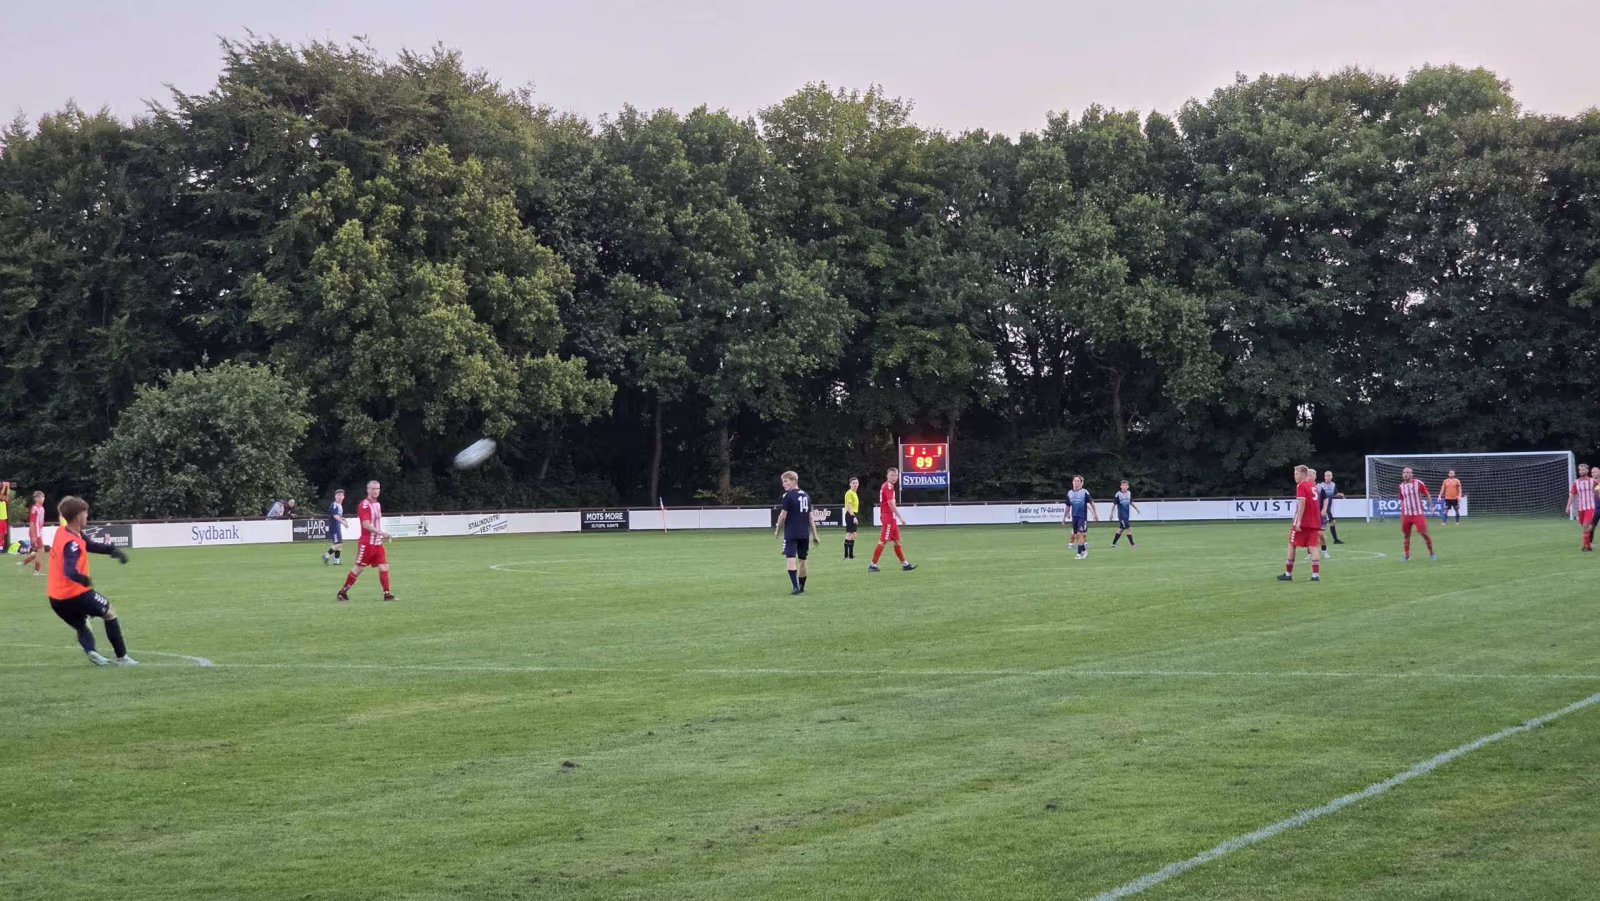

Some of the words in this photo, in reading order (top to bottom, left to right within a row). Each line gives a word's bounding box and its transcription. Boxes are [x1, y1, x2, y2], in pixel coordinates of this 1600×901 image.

[916, 456, 933, 468] 89
[903, 475, 946, 486] SYDBANK
[1312, 487, 1318, 501] 5
[798, 495, 809, 513] 14
[1236, 501, 1293, 512] KVIST
[586, 512, 604, 521] MOTS
[604, 512, 624, 520] MORE
[191, 525, 240, 544] Sydbank
